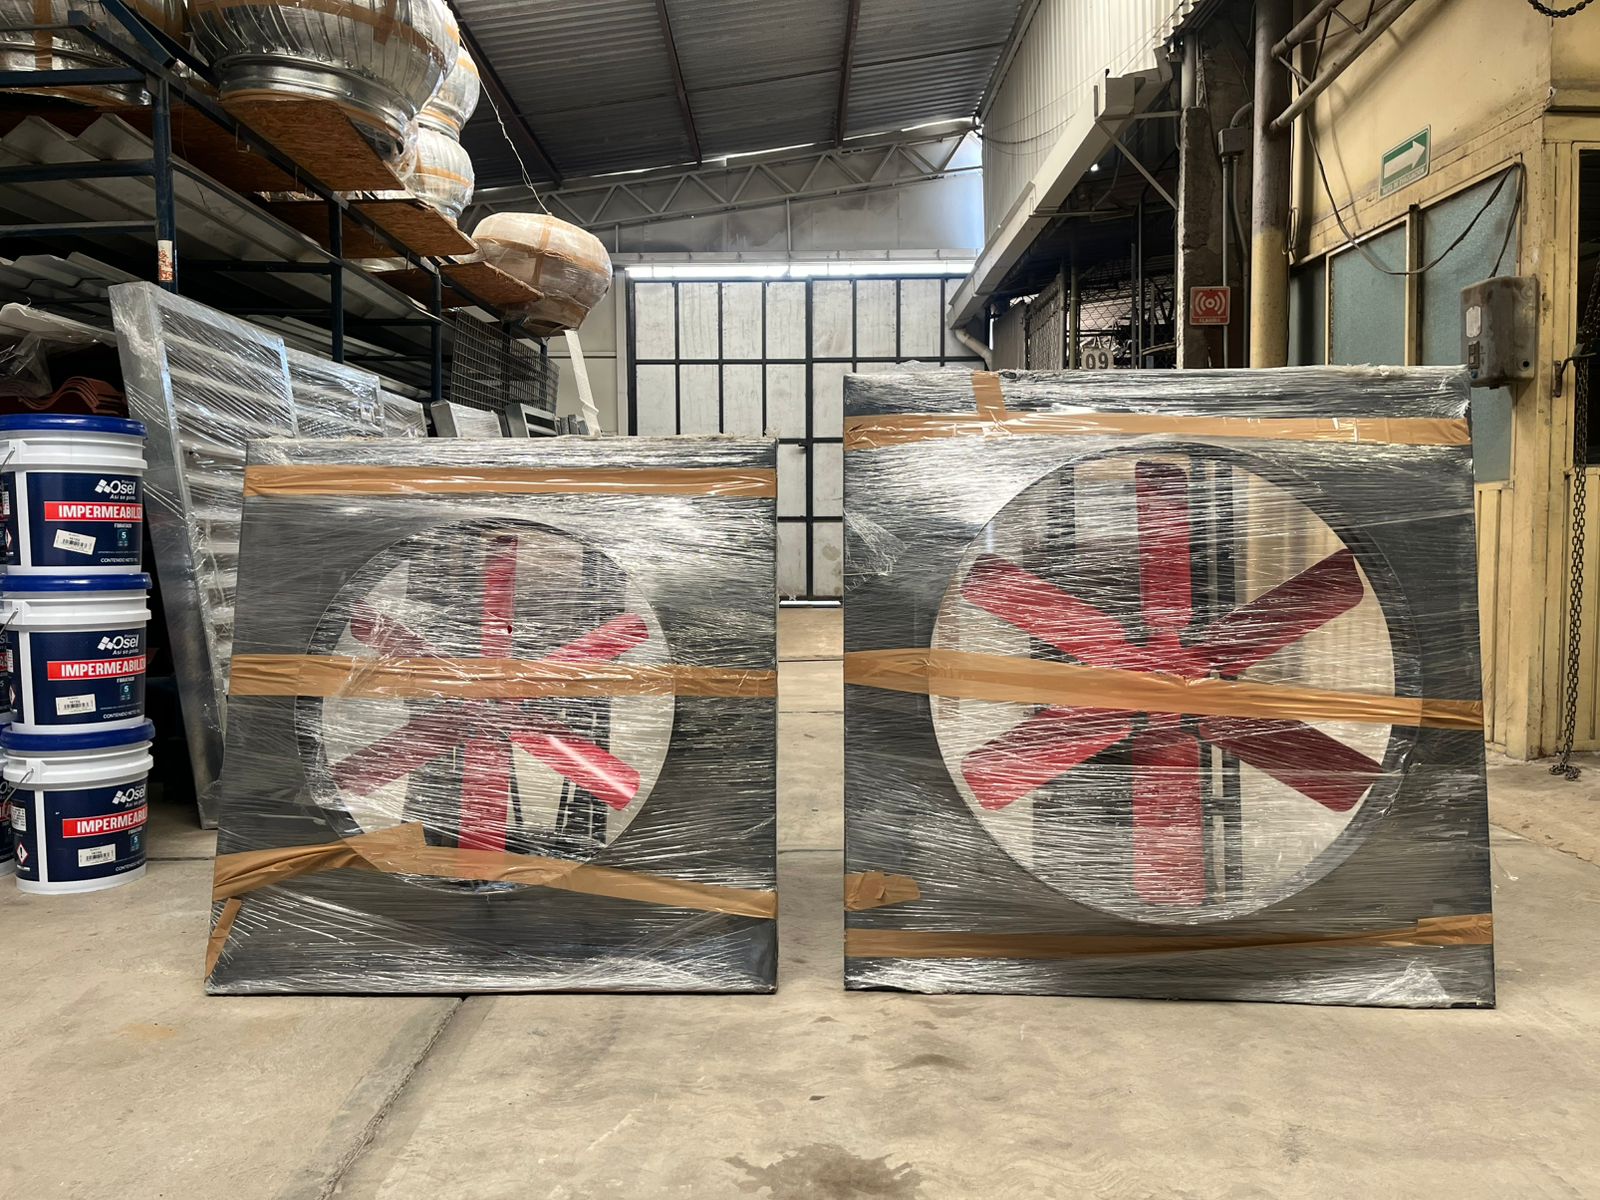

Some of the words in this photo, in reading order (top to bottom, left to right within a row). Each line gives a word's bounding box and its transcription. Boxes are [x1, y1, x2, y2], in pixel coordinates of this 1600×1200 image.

[1085, 352, 1109, 369] 09
[110, 480, 136, 494] Osel
[121, 531, 127, 539] 5
[113, 634, 139, 650] Osel
[123, 685, 129, 693] 5
